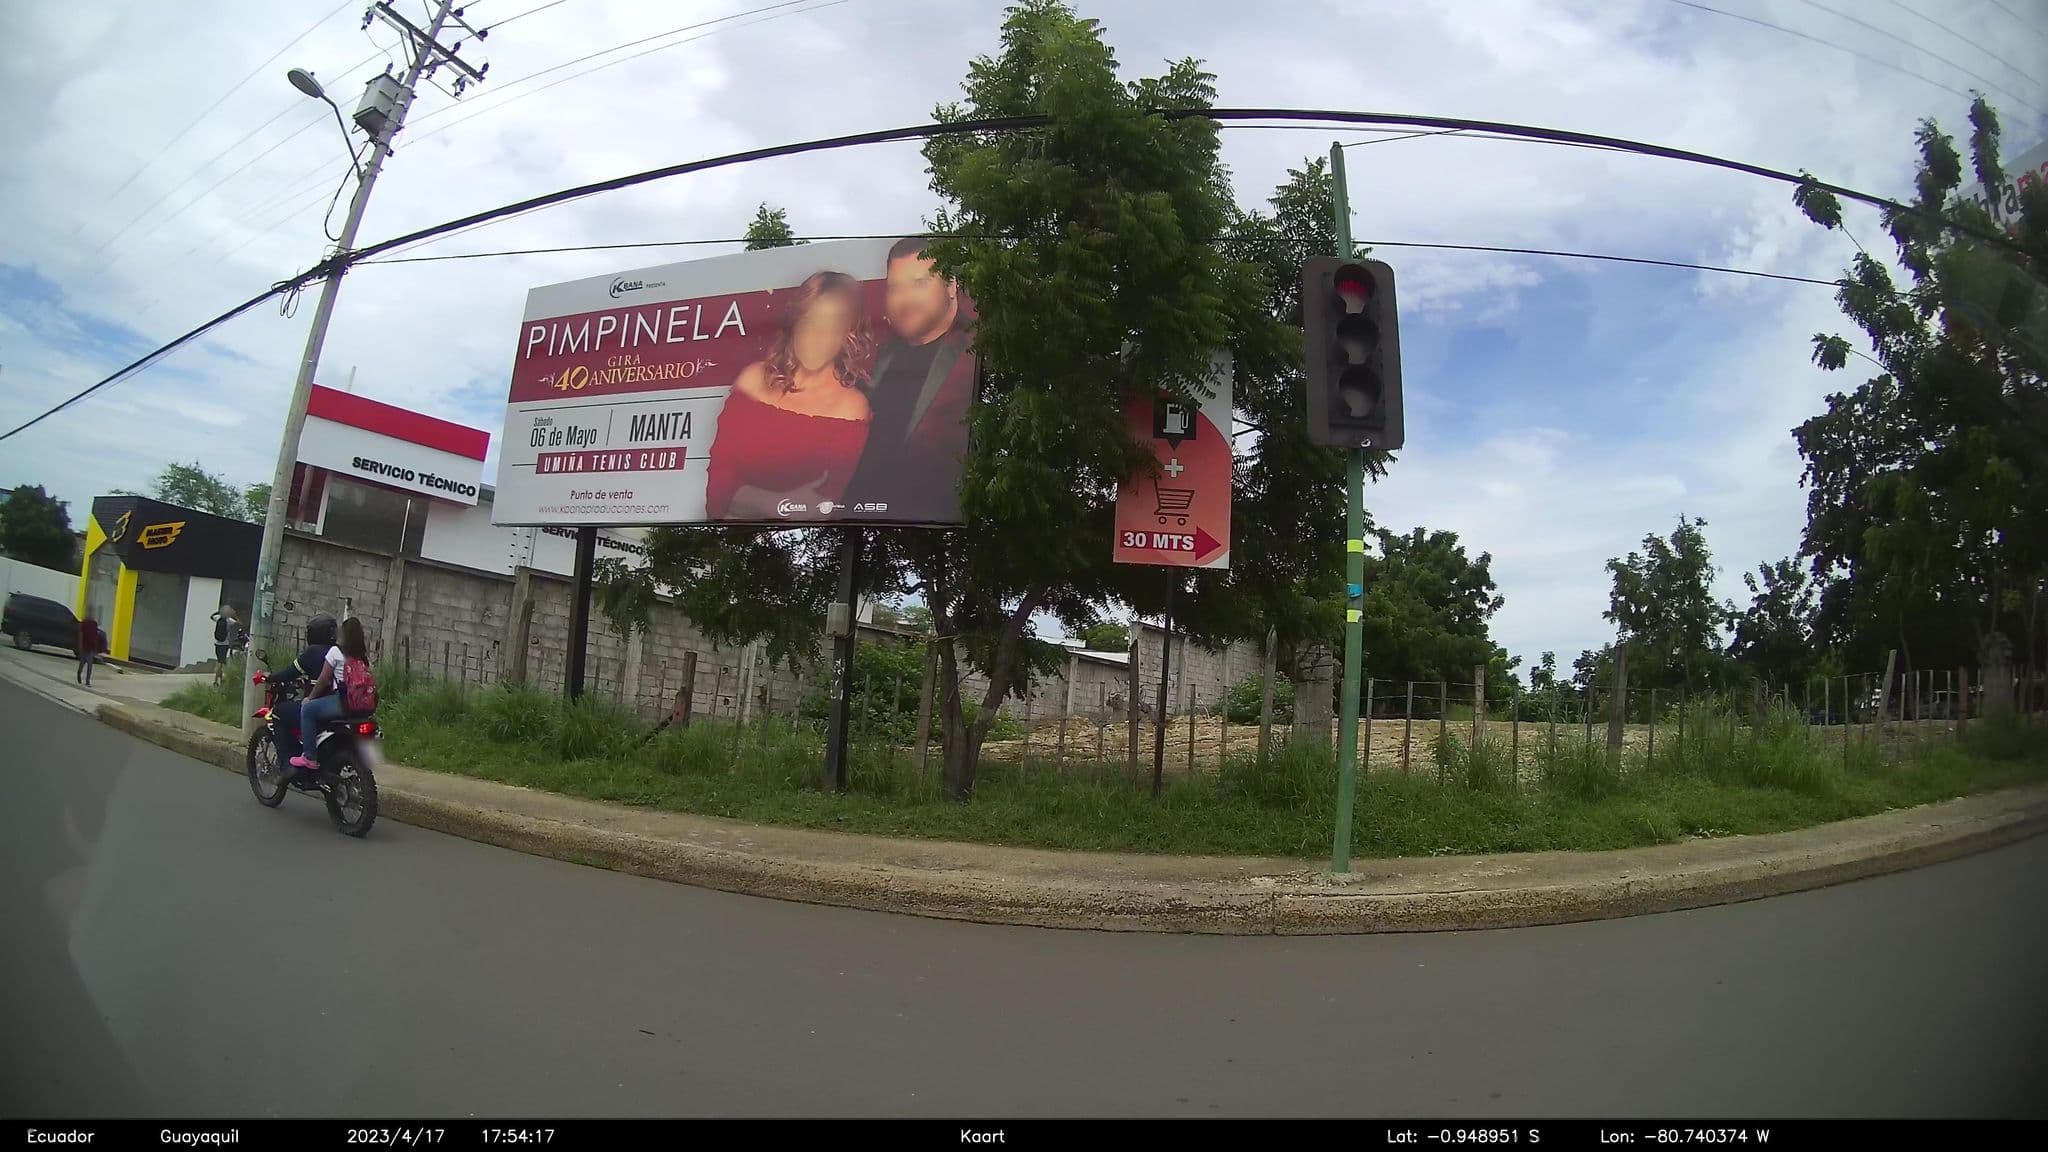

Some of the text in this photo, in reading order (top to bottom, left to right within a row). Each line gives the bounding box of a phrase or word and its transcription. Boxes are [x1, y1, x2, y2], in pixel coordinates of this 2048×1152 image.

[526, 300, 746, 359] PIMPINELA
[607, 354, 641, 368] GIRA
[554, 361, 695, 391] 40 ANIVERSARIO
[530, 425, 597, 448] 06 de Mayo
[629, 411, 692, 442] MANTA
[543, 452, 677, 472] UMIÑA TENIS CLUB
[352, 456, 476, 497] SERVICIO TÉCNICO
[570, 489, 633, 500] Punto de venta
[854, 503, 888, 511] ASB
[596, 536, 645, 556] TÉCNICO
[1123, 531, 1195, 550] 30 MTS
